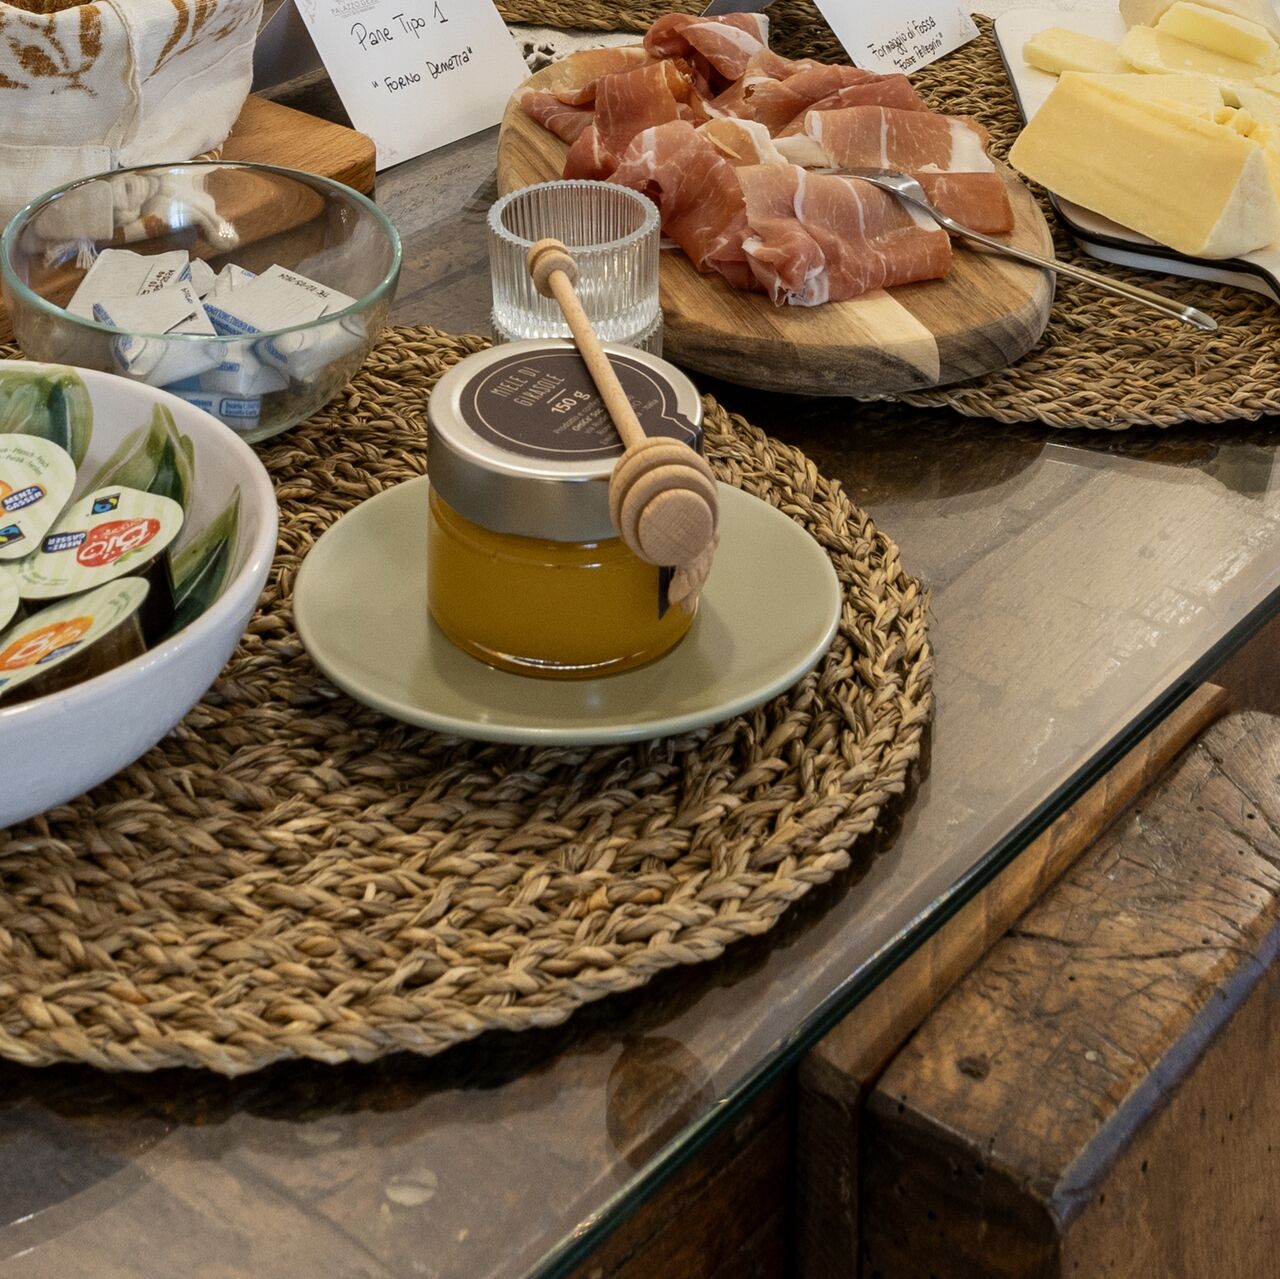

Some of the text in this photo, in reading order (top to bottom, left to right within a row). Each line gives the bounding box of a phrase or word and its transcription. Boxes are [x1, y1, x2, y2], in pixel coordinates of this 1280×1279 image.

[330, 0, 362, 15] PALAZZO
[350, 1, 449, 52] Pane Tipo 1
[907, 21, 915, 40] di
[489, 366, 541, 398] MIELE DI
[513, 373, 565, 407] GIRASOLE
[551, 397, 578, 414] 150
[573, 390, 591, 401] g
[2, 488, 34, 506] MENZ
[5, 491, 43, 512] GASSER
[48, 532, 87, 546] GASSER
[51, 538, 83, 551] MENZ
